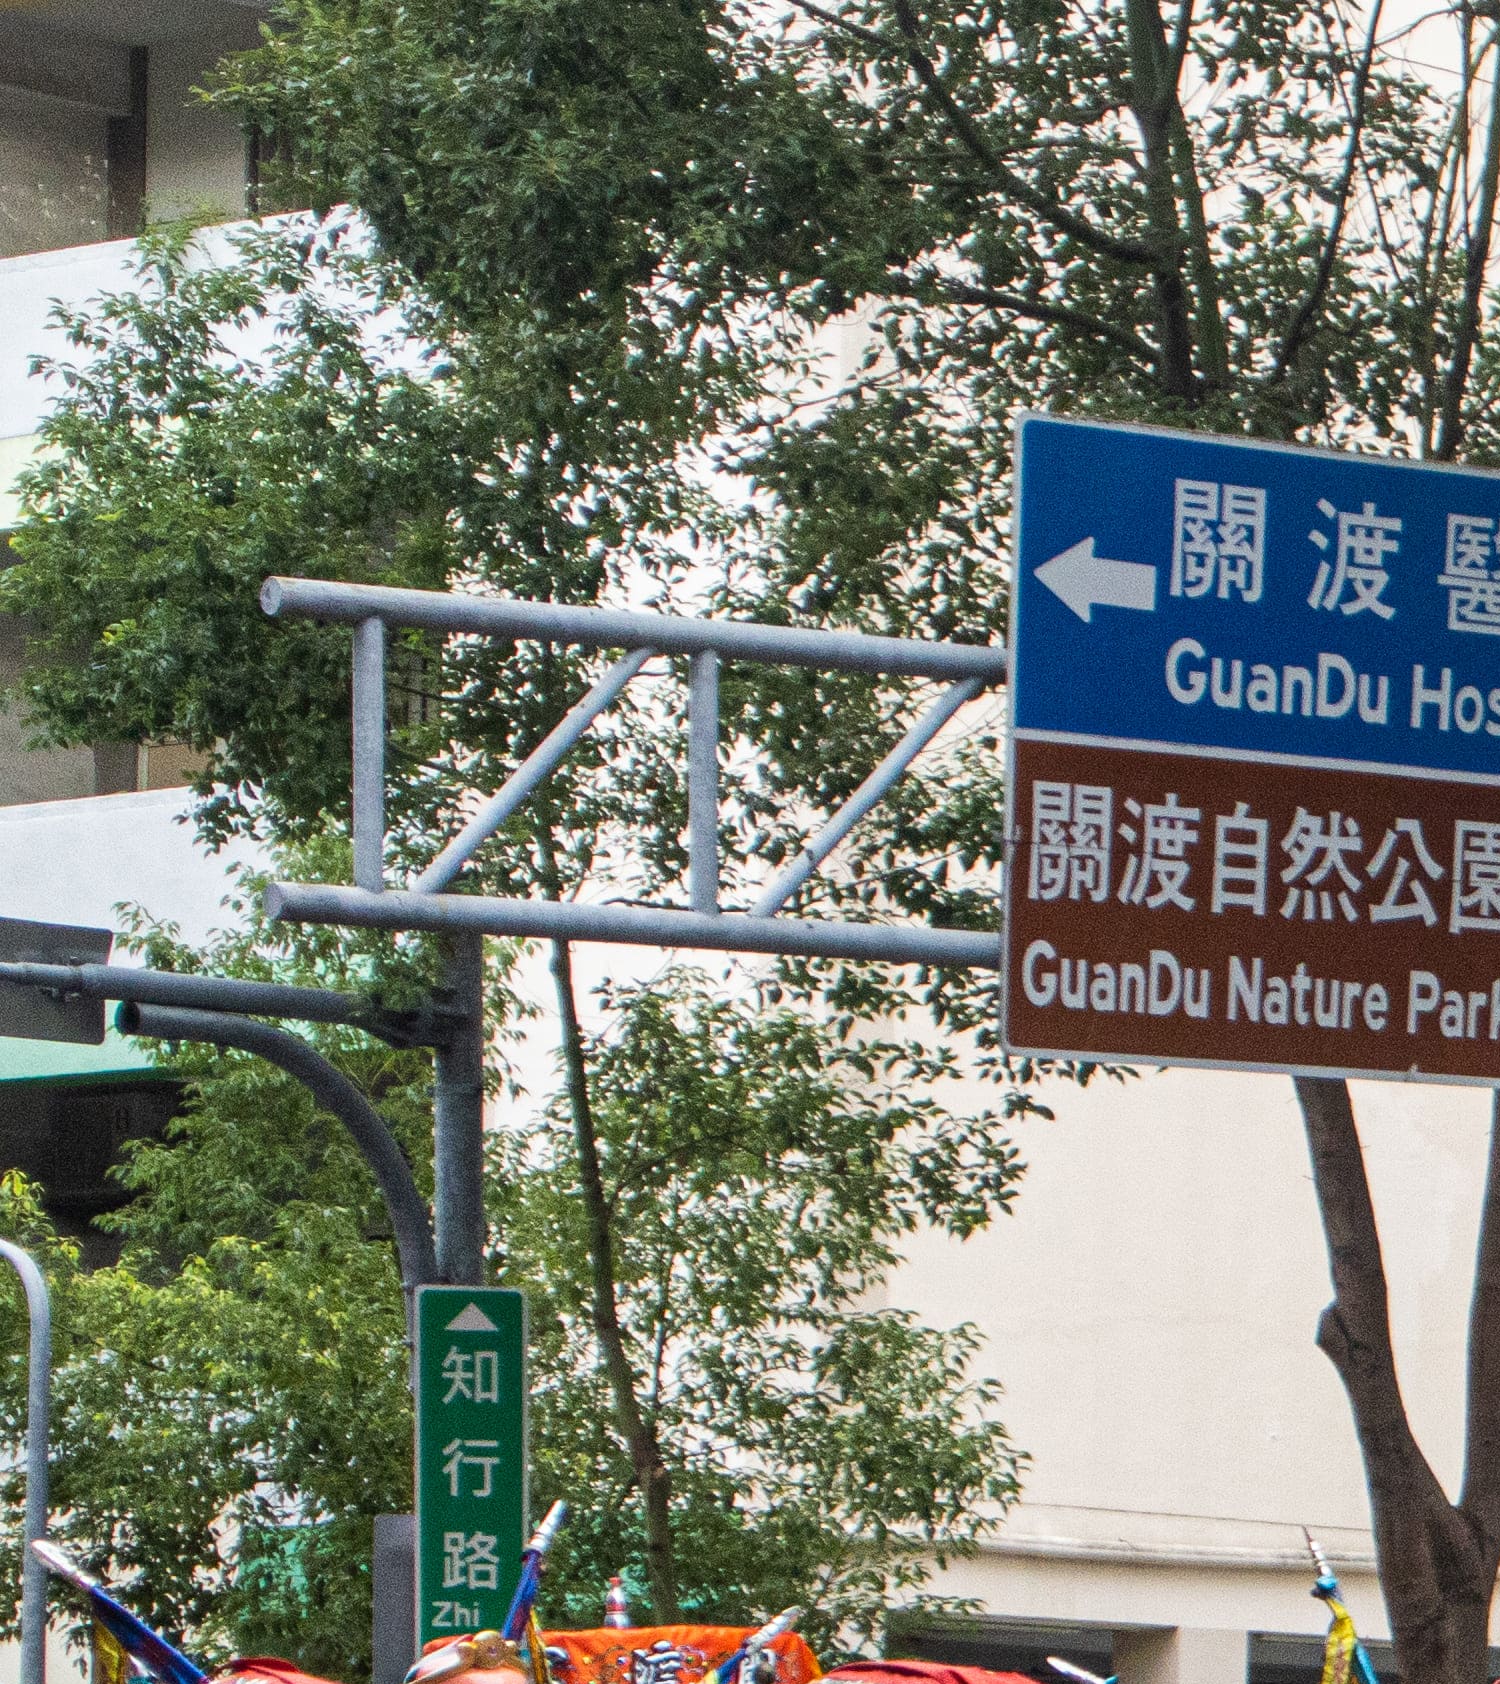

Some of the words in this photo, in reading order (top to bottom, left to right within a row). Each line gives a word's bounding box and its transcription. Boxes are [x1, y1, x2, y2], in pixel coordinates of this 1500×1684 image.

[1164, 638, 1390, 727] GuanDu
[1021, 938, 1212, 1019] GuanDu
[1227, 956, 1389, 1031] Nature
[441, 1344, 500, 1591] 知行路
[431, 1600, 481, 1629] Zhi
